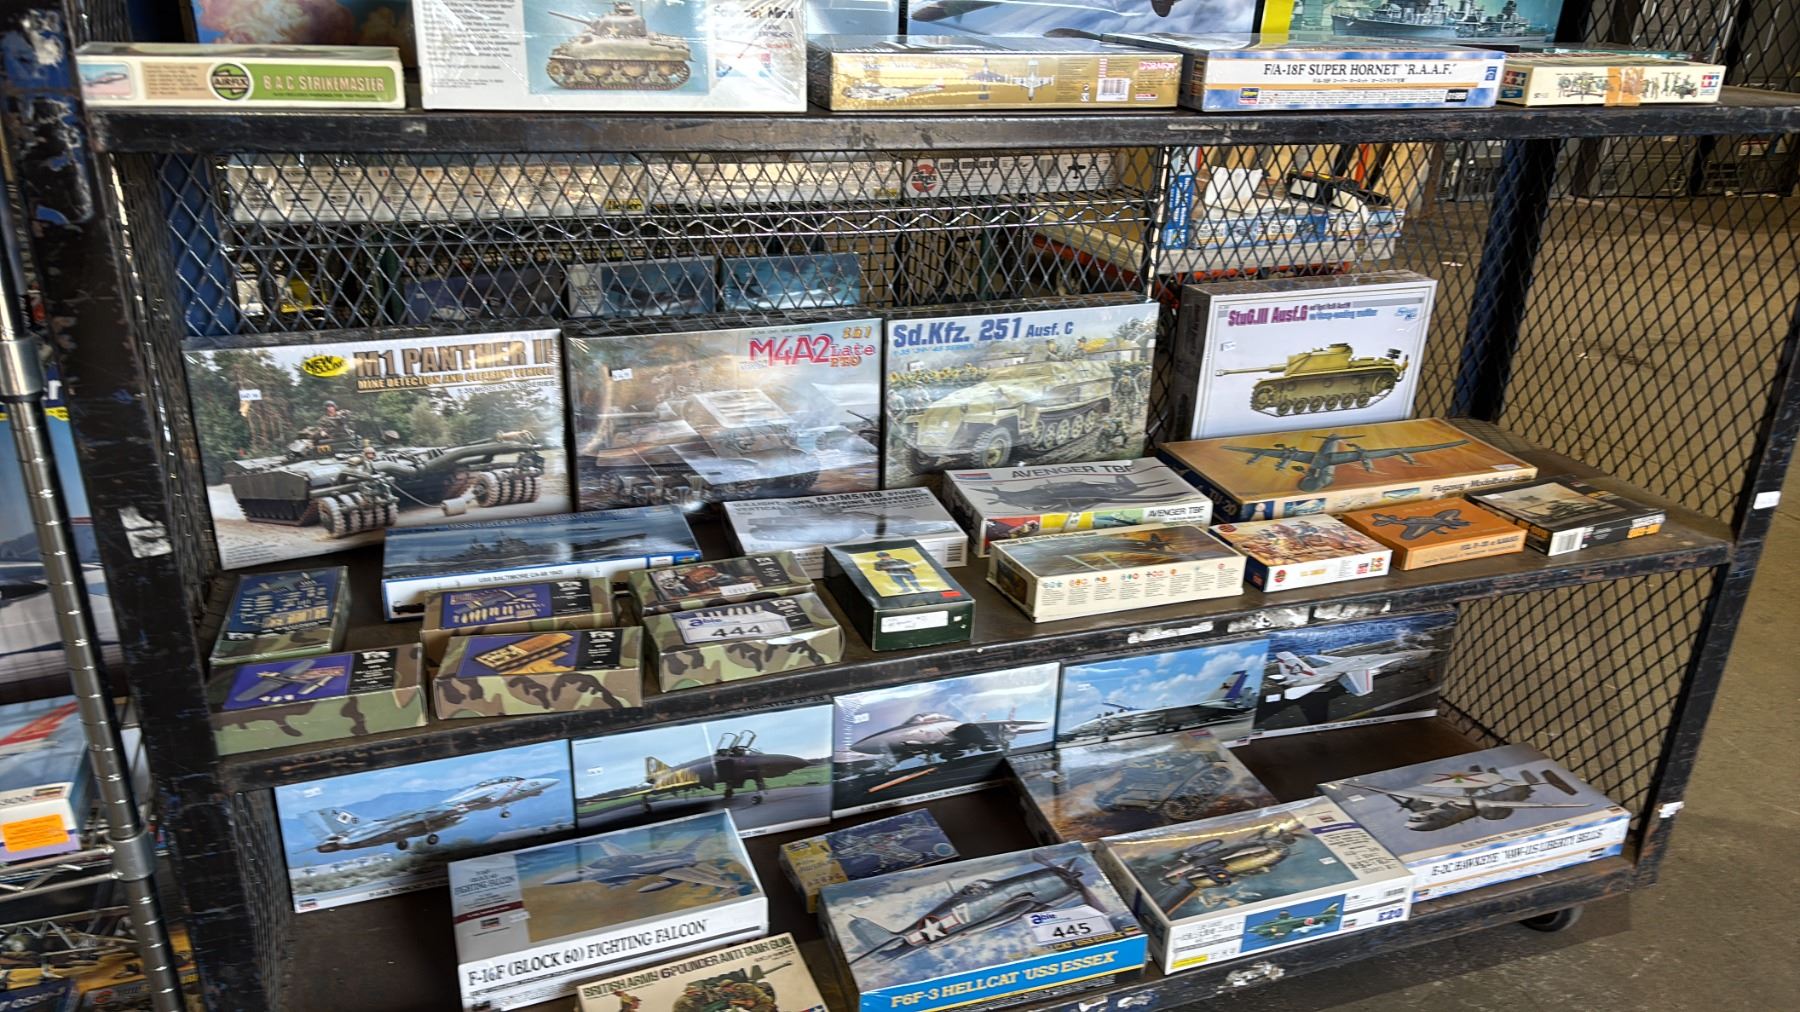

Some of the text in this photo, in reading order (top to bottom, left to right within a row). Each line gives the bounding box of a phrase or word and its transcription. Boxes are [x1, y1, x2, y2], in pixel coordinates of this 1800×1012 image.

[1263, 63, 1306, 76] F/A-18F
[1308, 63, 1348, 76] SUPER
[1350, 63, 1399, 76] HORNET
[263, 75, 272, 90] B
[275, 76, 284, 90] A
[298, 76, 385, 92] STRIKEMASTER
[892, 316, 1074, 348] Sd.Kfz. 251 Ausf. C
[353, 349, 396, 378] M1
[401, 340, 527, 376] PANTHER
[748, 333, 833, 367] M4A2
[830, 342, 876, 357] Late
[357, 378, 385, 391] MINE
[386, 375, 441, 388] DETECTION
[443, 372, 465, 384] AND
[1011, 464, 1097, 479] AVENGER
[711, 625, 763, 637] 444
[1052, 922, 1092, 939] 445
[507, 951, 561, 978] (BLOCK
[586, 930, 654, 959] FIGHTING
[653, 918, 710, 944] FALCON
[582, 979, 628, 999] BRITISH
[768, 935, 793, 951] GUN
[890, 988, 940, 1008] F6F-3
[941, 971, 1021, 998] HELLCAT
